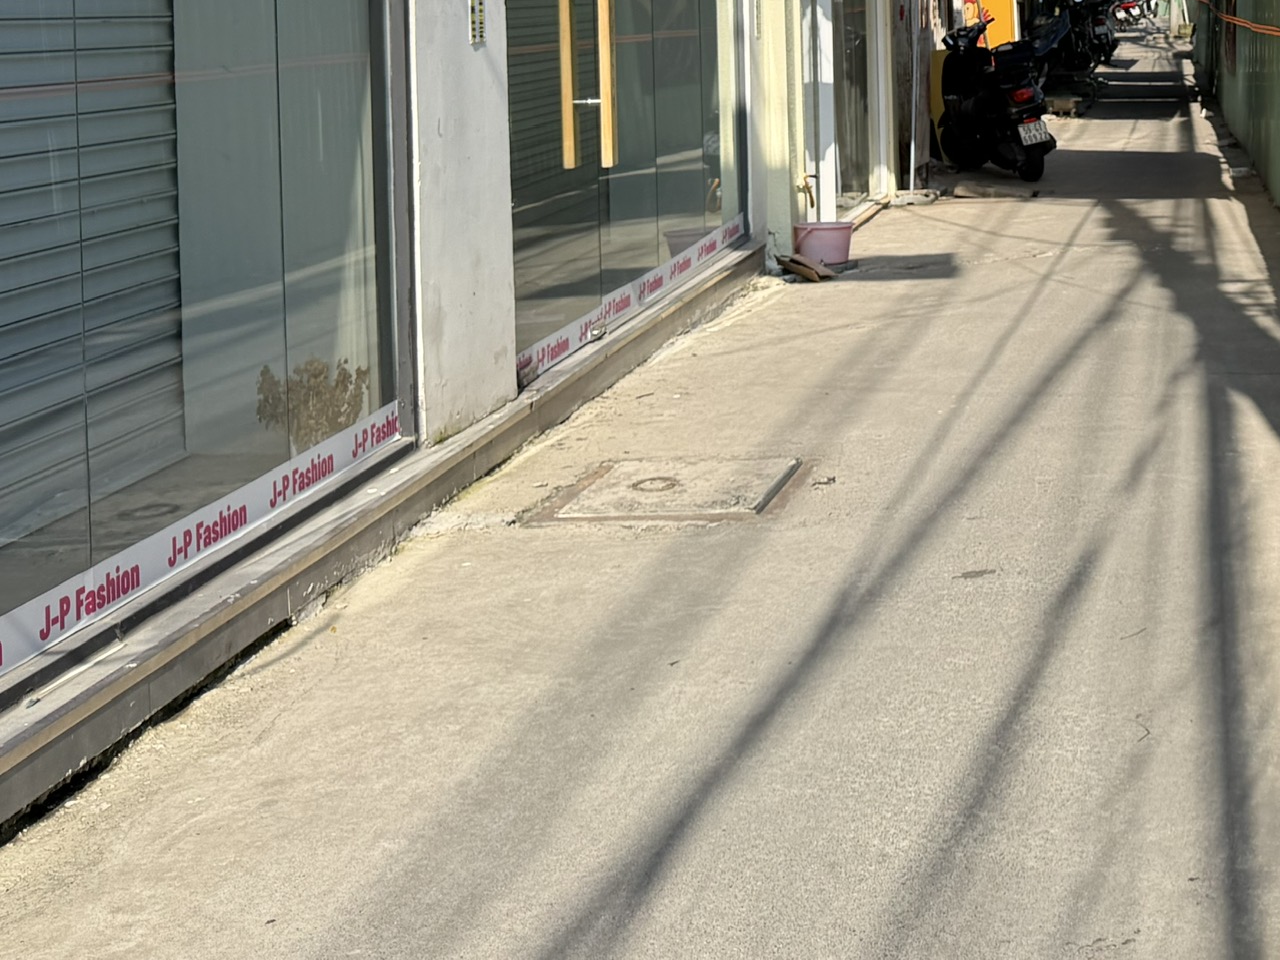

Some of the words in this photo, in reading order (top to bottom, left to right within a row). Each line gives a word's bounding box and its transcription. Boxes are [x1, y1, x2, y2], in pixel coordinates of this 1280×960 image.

[352, 428, 368, 459] J-P
[269, 474, 289, 508] J-P
[292, 452, 334, 494] Fashion
[168, 528, 192, 568] J-P
[196, 503, 247, 552] Fashion
[39, 595, 71, 641] J-P
[75, 563, 140, 621] Fashion
